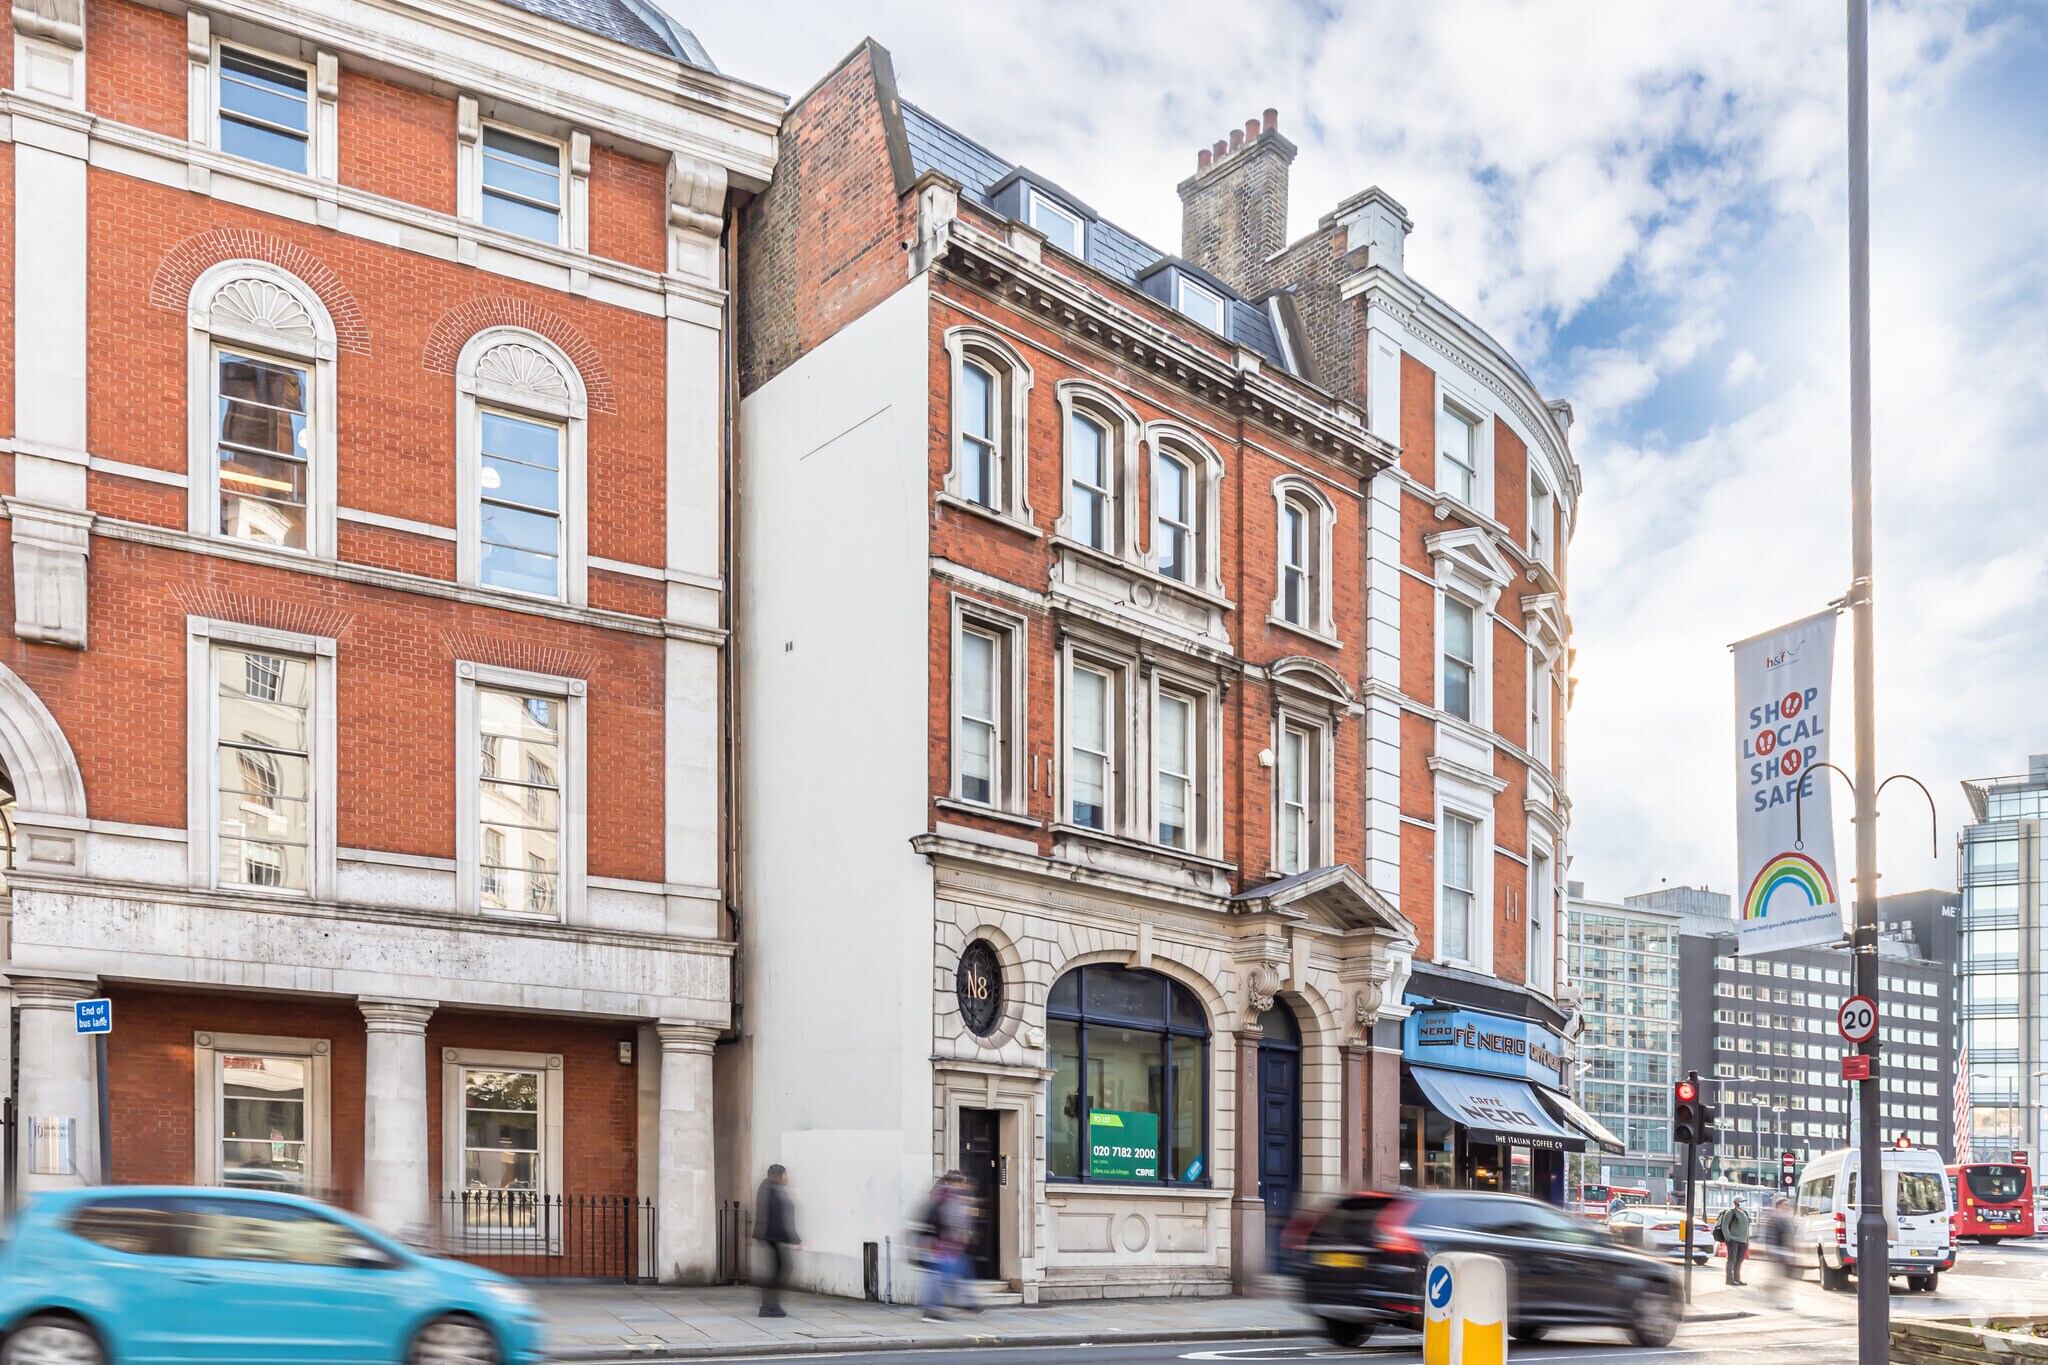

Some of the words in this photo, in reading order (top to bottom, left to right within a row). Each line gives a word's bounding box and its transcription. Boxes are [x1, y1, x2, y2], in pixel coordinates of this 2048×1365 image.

[1766, 650, 1786, 669] h&f
[1750, 687, 1818, 730] SHOP
[1743, 715, 1824, 760] LOCAL
[1751, 745, 1817, 786] SHOP
[1755, 775, 1813, 812] SAFE
[1941, 905, 1960, 918] ME
[81, 1005, 95, 1016] End
[96, 1004, 104, 1015] of
[79, 1018, 91, 1028] bus
[92, 1016, 107, 1027] lane
[1844, 1008, 1872, 1030] 20
[1420, 1027, 1452, 1036] NERO
[1478, 1031, 1526, 1056] NERO
[1459, 1104, 1538, 1127] NERO
[1495, 1135, 1506, 1143] THE
[1508, 1136, 1531, 1146] ITALIAN
[1532, 1139, 1553, 1149] COFFEE
[1093, 1145, 1109, 1156] 020
[1112, 1146, 1132, 1157] 7182
[1134, 1148, 1155, 1159] 2000
[1135, 1168, 1154, 1176] CBRE
[1989, 1166, 2002, 1176] 72
